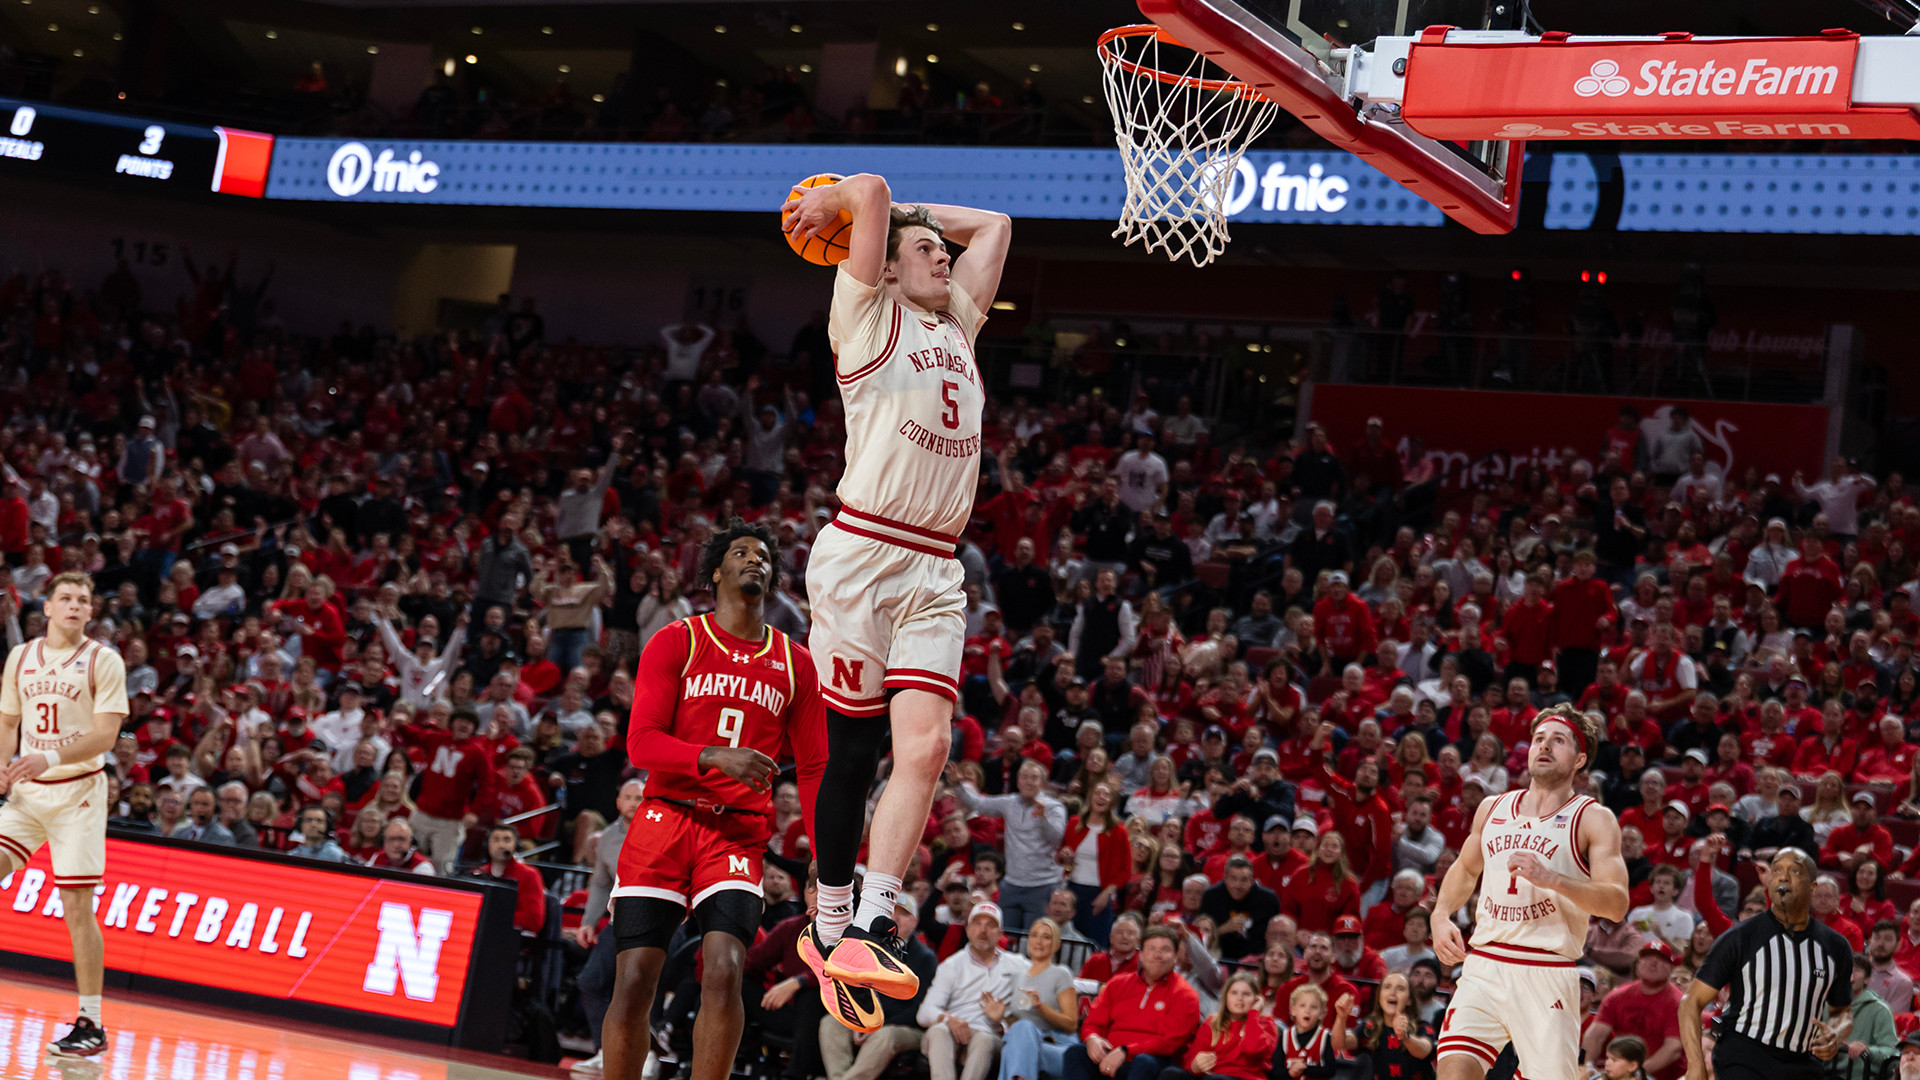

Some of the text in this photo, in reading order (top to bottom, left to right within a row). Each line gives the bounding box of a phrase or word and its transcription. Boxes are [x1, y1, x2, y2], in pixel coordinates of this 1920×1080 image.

[10, 106, 36, 136] 0
[139, 125, 165, 155] 3
[115, 154, 174, 180] POINTS
[1260, 161, 1349, 213] fnic
[111, 237, 168, 266] 115
[695, 288, 744, 311] 116
[941, 378, 960, 430] 5
[832, 654, 865, 693] N
[23, 681, 82, 702] NEBRASKA
[684, 673, 785, 717] MARYLAND
[36, 702, 60, 735] 31
[717, 706, 745, 748] 9
[430, 745, 465, 778] N
[1486, 834, 1560, 861] NEBRASKA
[728, 854, 750, 876] M
[362, 901, 454, 1003] N
